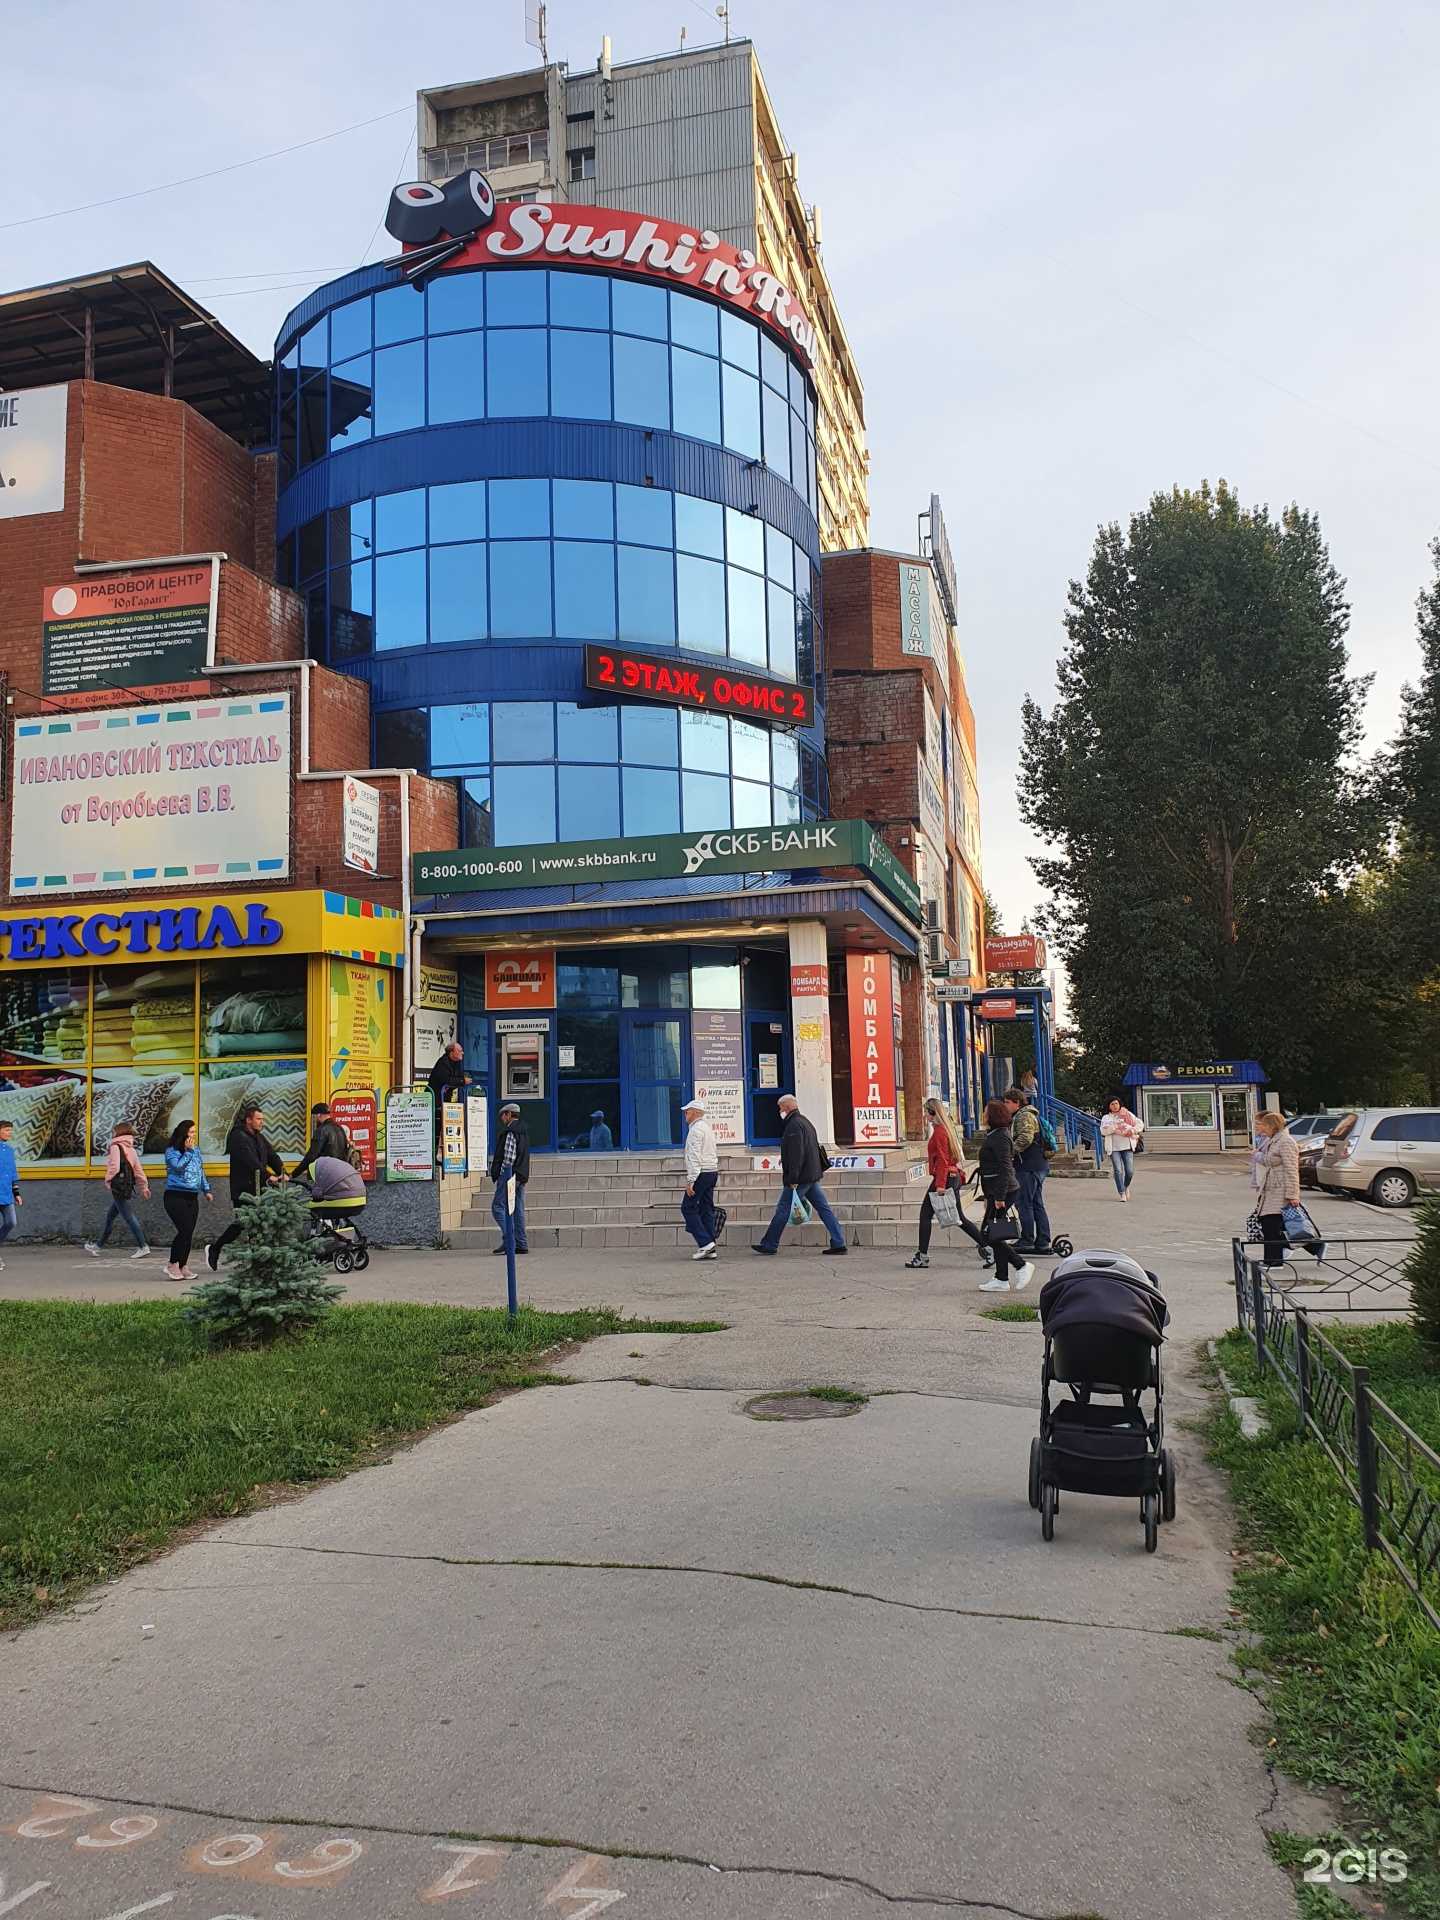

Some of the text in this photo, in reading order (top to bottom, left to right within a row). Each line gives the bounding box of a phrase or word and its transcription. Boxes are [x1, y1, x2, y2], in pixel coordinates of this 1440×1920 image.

[81, 573, 204, 598] ПРАВОВОЙ ЦЕНТР
[905, 567, 925, 654] МАССАЖ
[598, 655, 806, 719] 2 ЭТАЖ, ОФИС 2
[20, 735, 282, 785] ИВАНОВСКИЙ ТЕКСТИЛЬ
[61, 785, 236, 826] от Воробьева В.В.
[715, 826, 838, 856] СКБ-БАНК
[421, 850, 657, 880] 8-800-1000-600 www.skbbank.ru
[497, 960, 543, 994] 24
[792, 977, 821, 986] ЛОМБАРД
[862, 955, 881, 1104] ЛОМБАРД
[1177, 1065, 1233, 1075] РЕМОНТ
[335, 1103, 371, 1112] ЛОМБАРД
[856, 1109, 894, 1120] РАНТЬЕ
[712, 1122, 728, 1131] ВХОД
